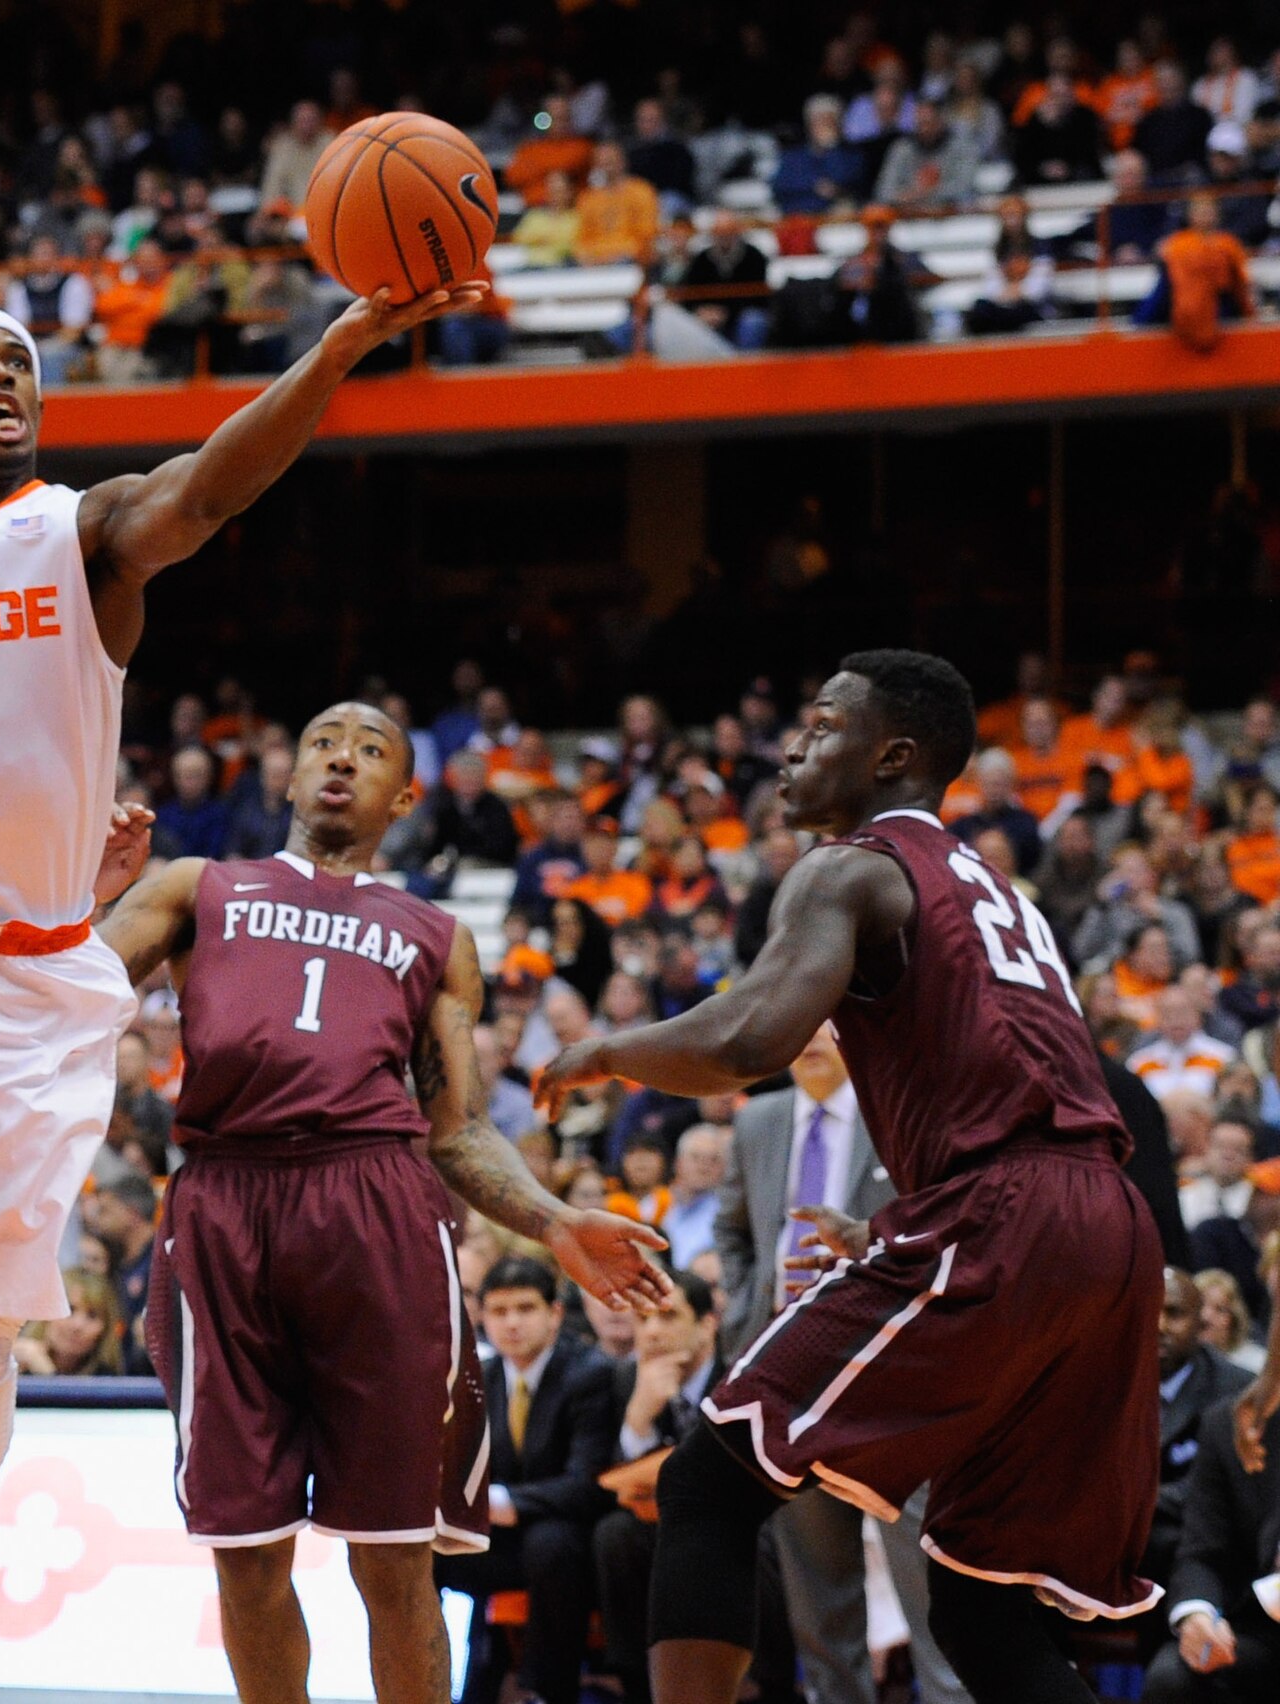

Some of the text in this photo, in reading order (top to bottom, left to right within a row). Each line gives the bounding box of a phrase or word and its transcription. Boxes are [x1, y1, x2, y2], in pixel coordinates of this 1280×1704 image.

[223, 900, 420, 981] FORDHAM
[947, 851, 1084, 1019] 24
[293, 956, 327, 1034] 1
